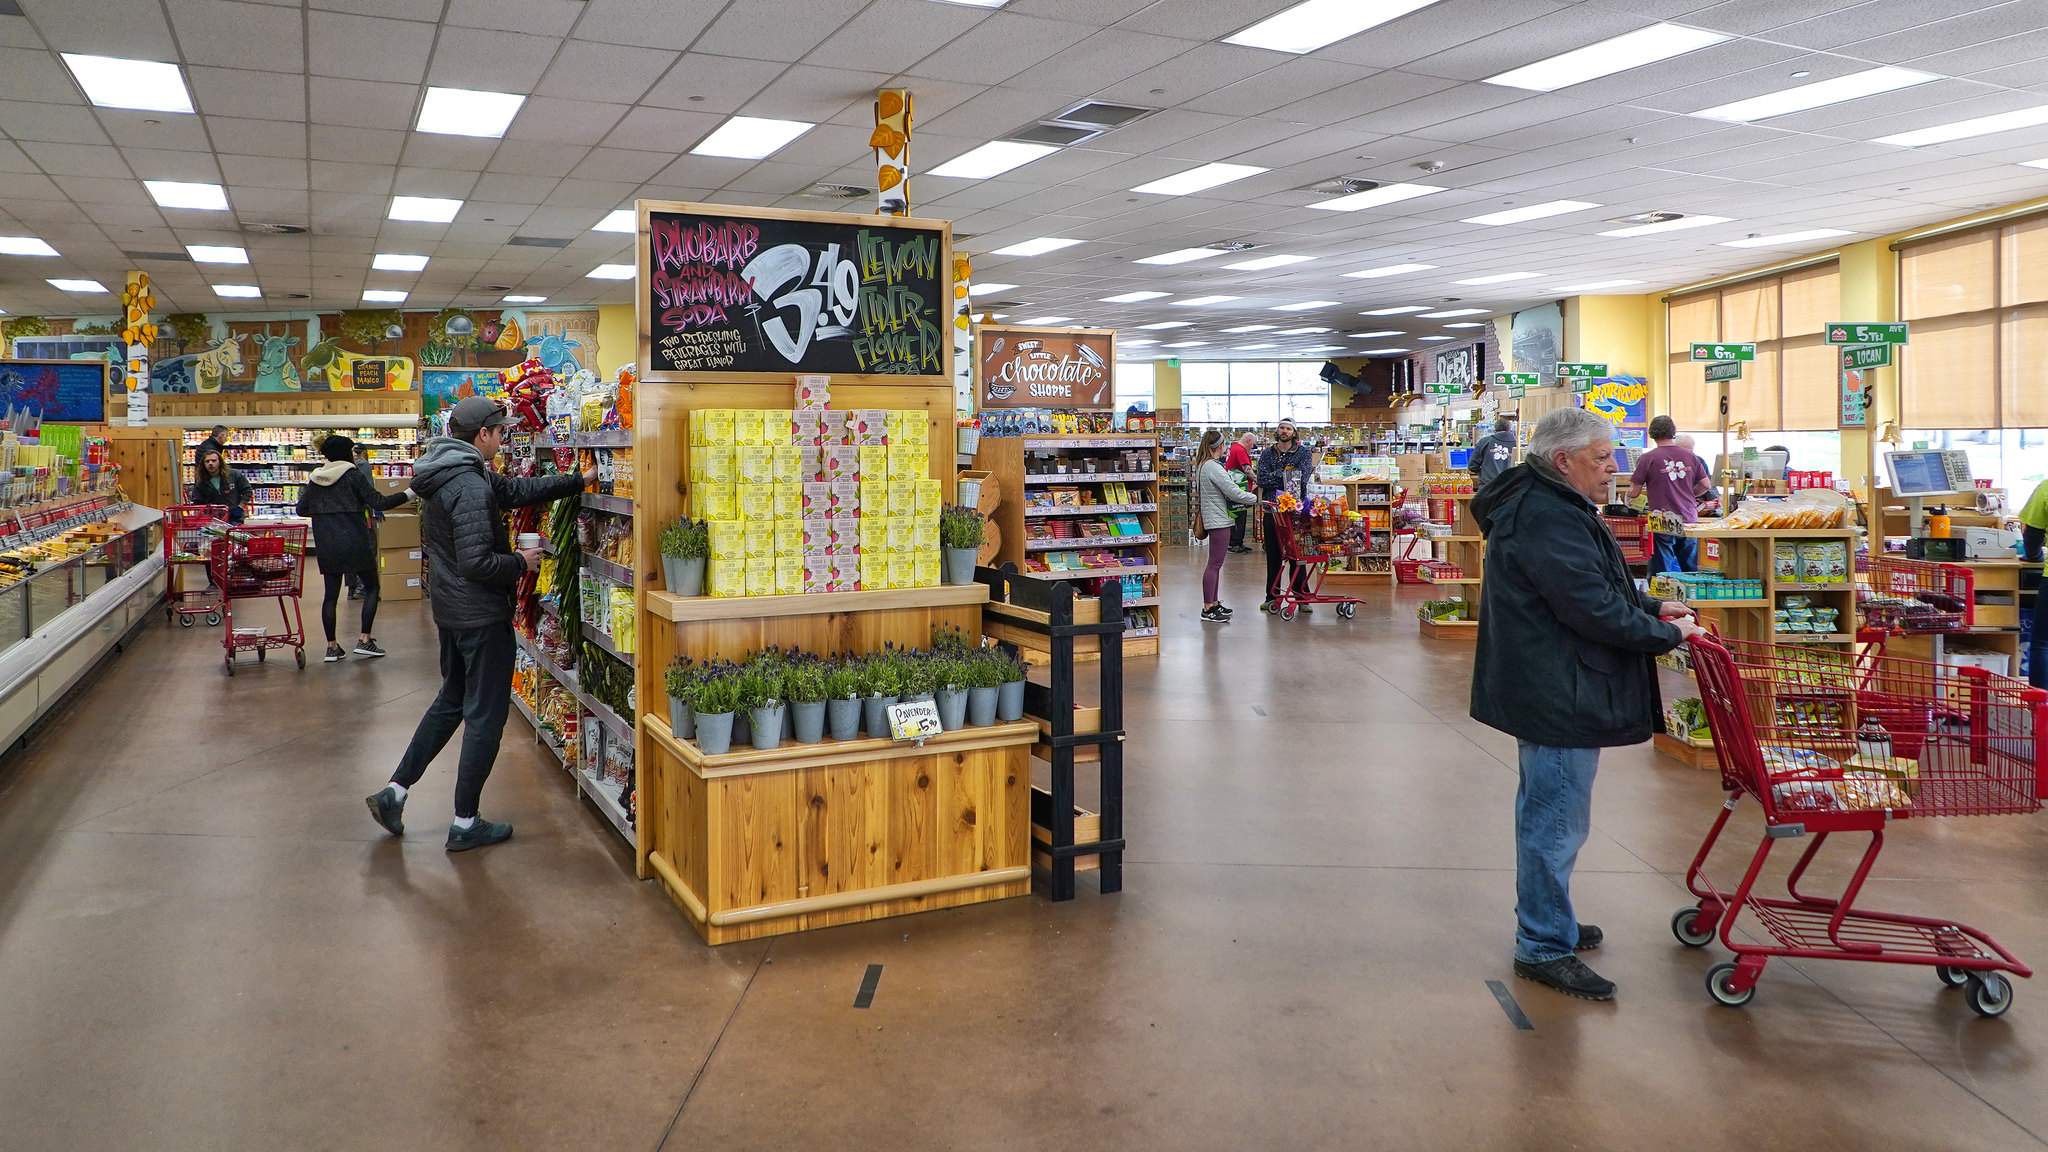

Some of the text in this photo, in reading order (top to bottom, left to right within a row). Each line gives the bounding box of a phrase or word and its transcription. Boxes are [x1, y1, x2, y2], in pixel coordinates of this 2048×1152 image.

[650, 219, 760, 271] RHUBARB
[857, 229, 940, 285] LEMON
[680, 262, 714, 280] AND
[652, 269, 755, 308] STRAWBERRY
[660, 304, 729, 333] SODA
[659, 329, 741, 348] TWO REFRESHING
[1856, 325, 1904, 341] 5TH AVE
[661, 341, 747, 361] BEVERAGES WITH
[852, 319, 942, 371] FLOWER
[1017, 340, 1039, 351] SWEET
[1714, 346, 1735, 359] 6TH
[674, 355, 734, 370] GREAT FLAVOR
[1030, 352, 1051, 360] LITTLE
[874, 362, 921, 375] SODA
[999, 355, 1099, 386] Chocolate
[1438, 351, 1470, 387] BEER
[1572, 366, 1590, 375] 7TH
[357, 377, 380, 385] MANGO
[1510, 374, 1525, 384] 8TH
[1029, 383, 1072, 398] SHOPPE
[1862, 384, 1873, 409] 5
[1720, 395, 1728, 415] 6
[895, 707, 931, 724] LAVENDER
